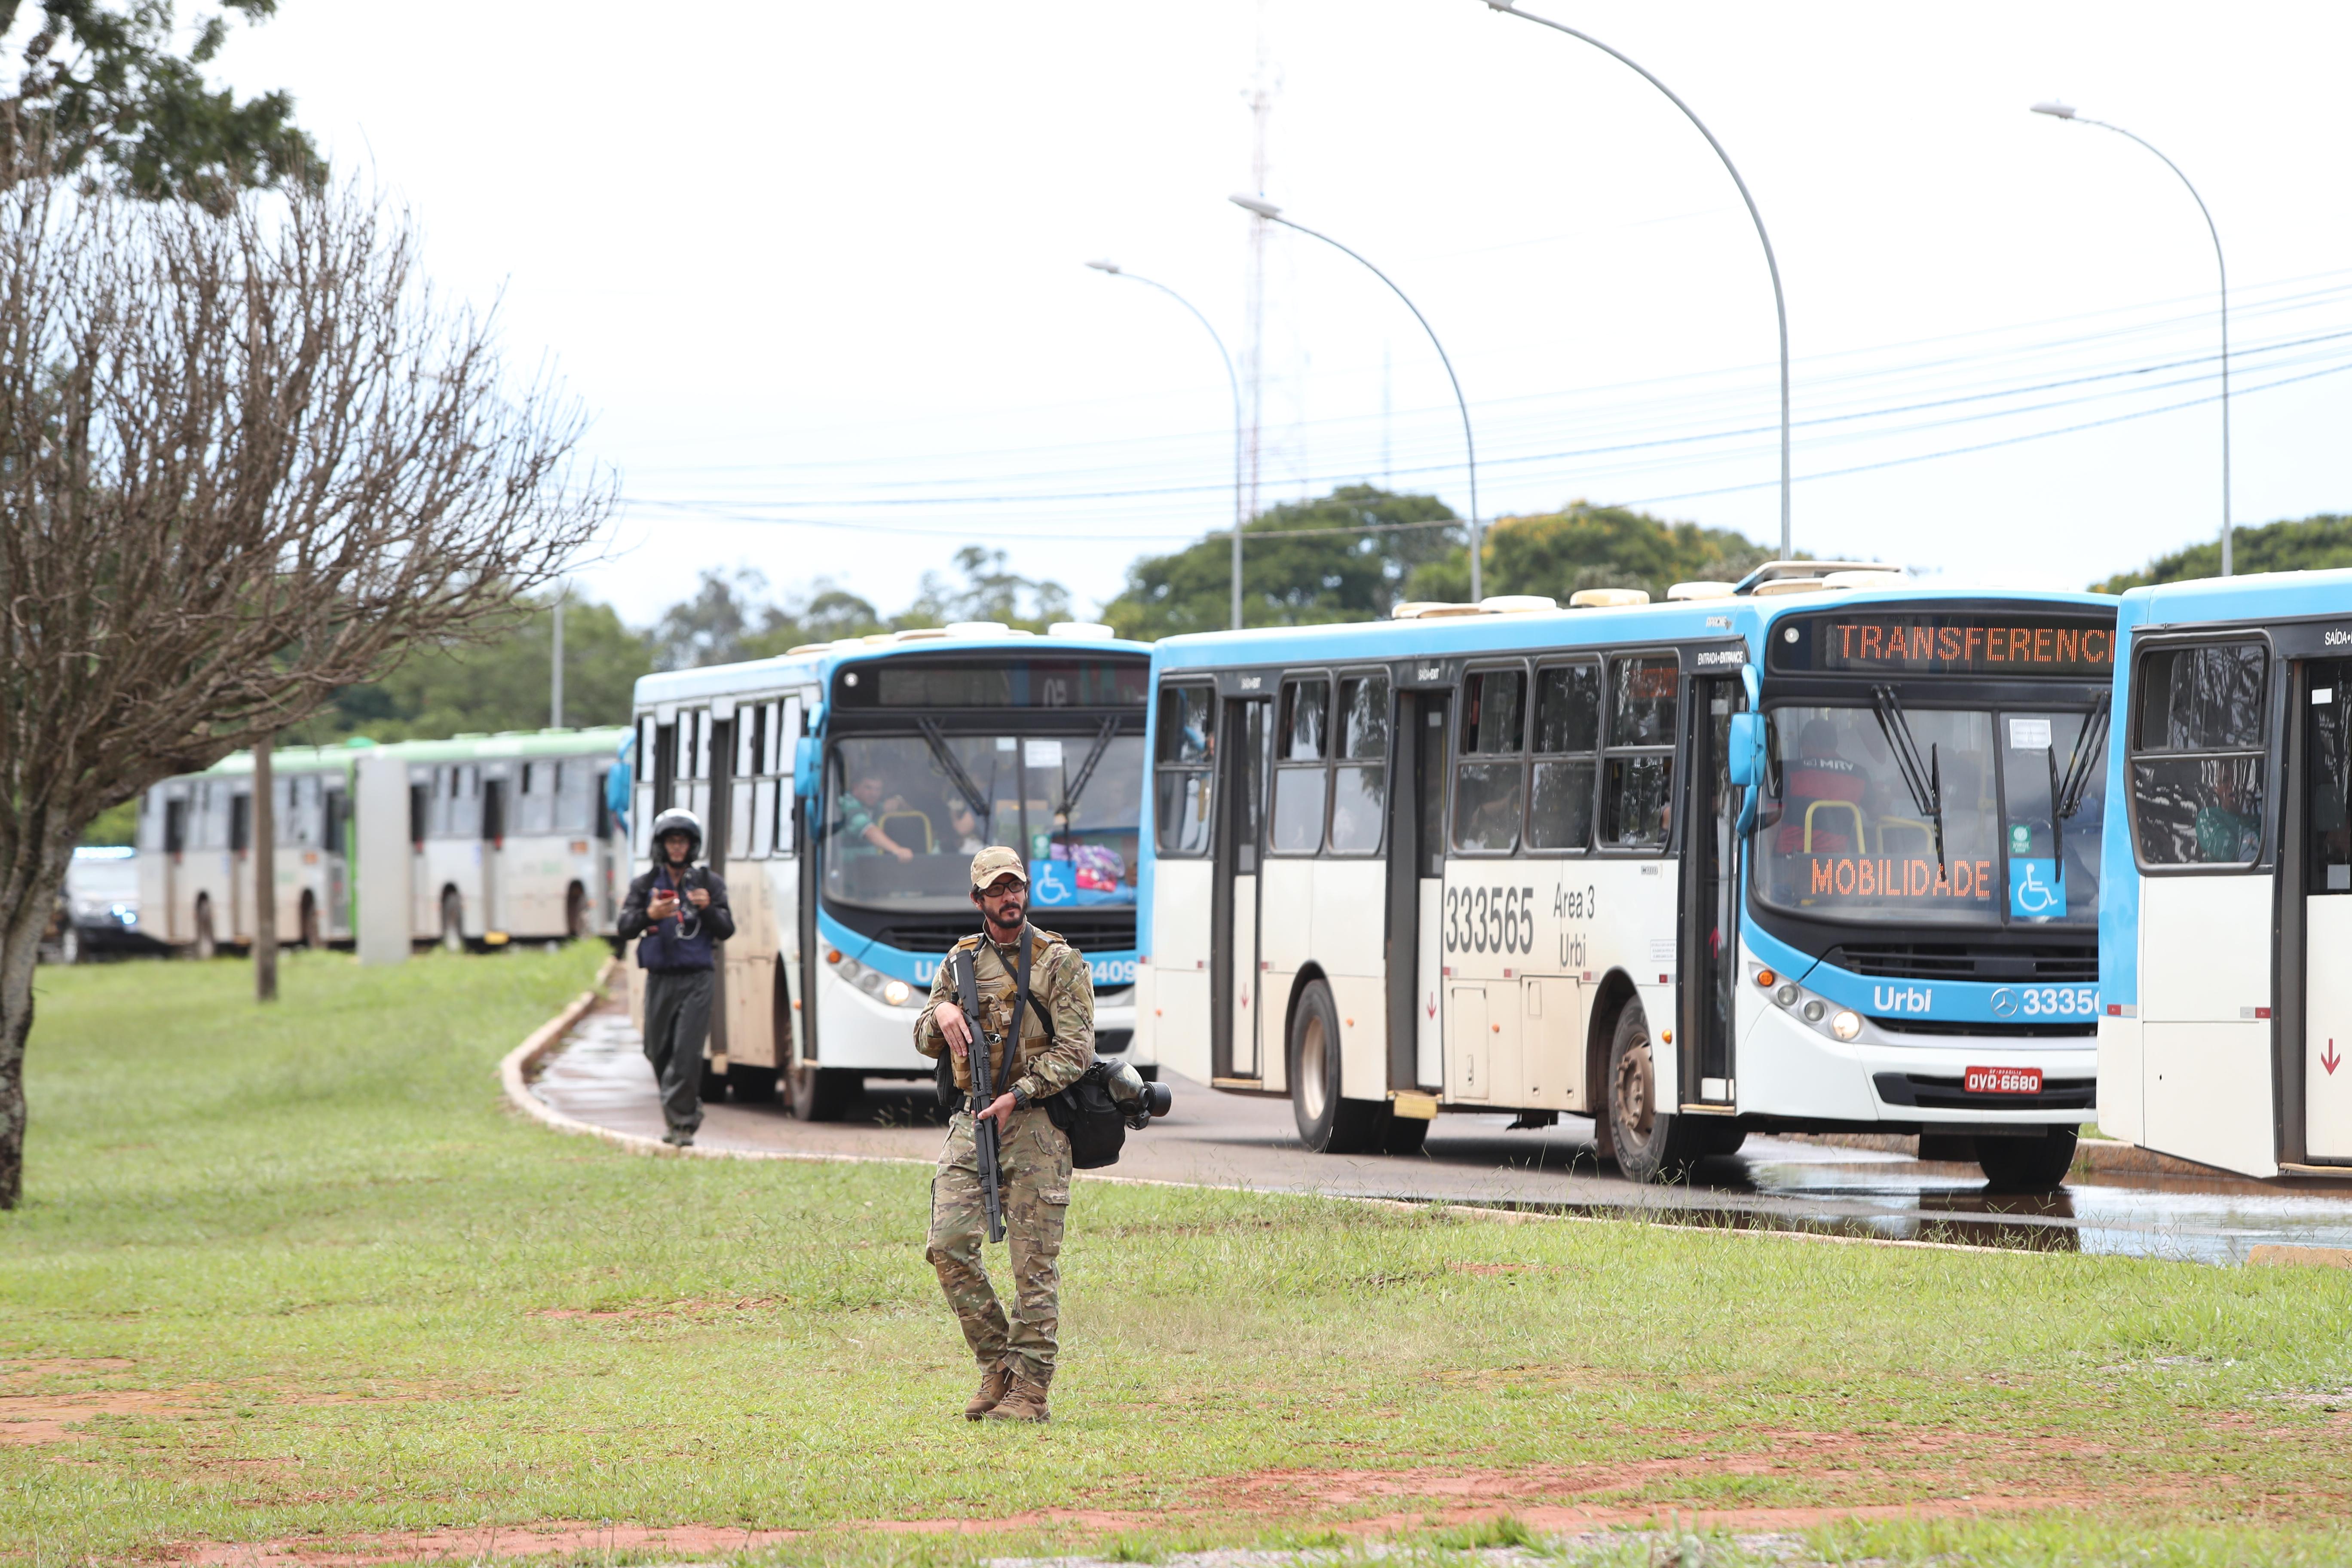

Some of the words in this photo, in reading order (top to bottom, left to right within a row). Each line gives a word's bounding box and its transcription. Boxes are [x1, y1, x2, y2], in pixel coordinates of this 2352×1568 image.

[2325, 628, 2352, 646] SAÍDA•
[1820, 759, 1853, 771] MRV
[1812, 859, 1990, 897] MOBILIDADE
[1553, 882, 1583, 919] Area
[1587, 884, 1595, 919] 3
[1446, 886, 1534, 954] 333565
[1560, 933, 1586, 968] Urbi
[1874, 986, 1932, 1013] Urbi
[2023, 988, 2100, 1015] 3335
